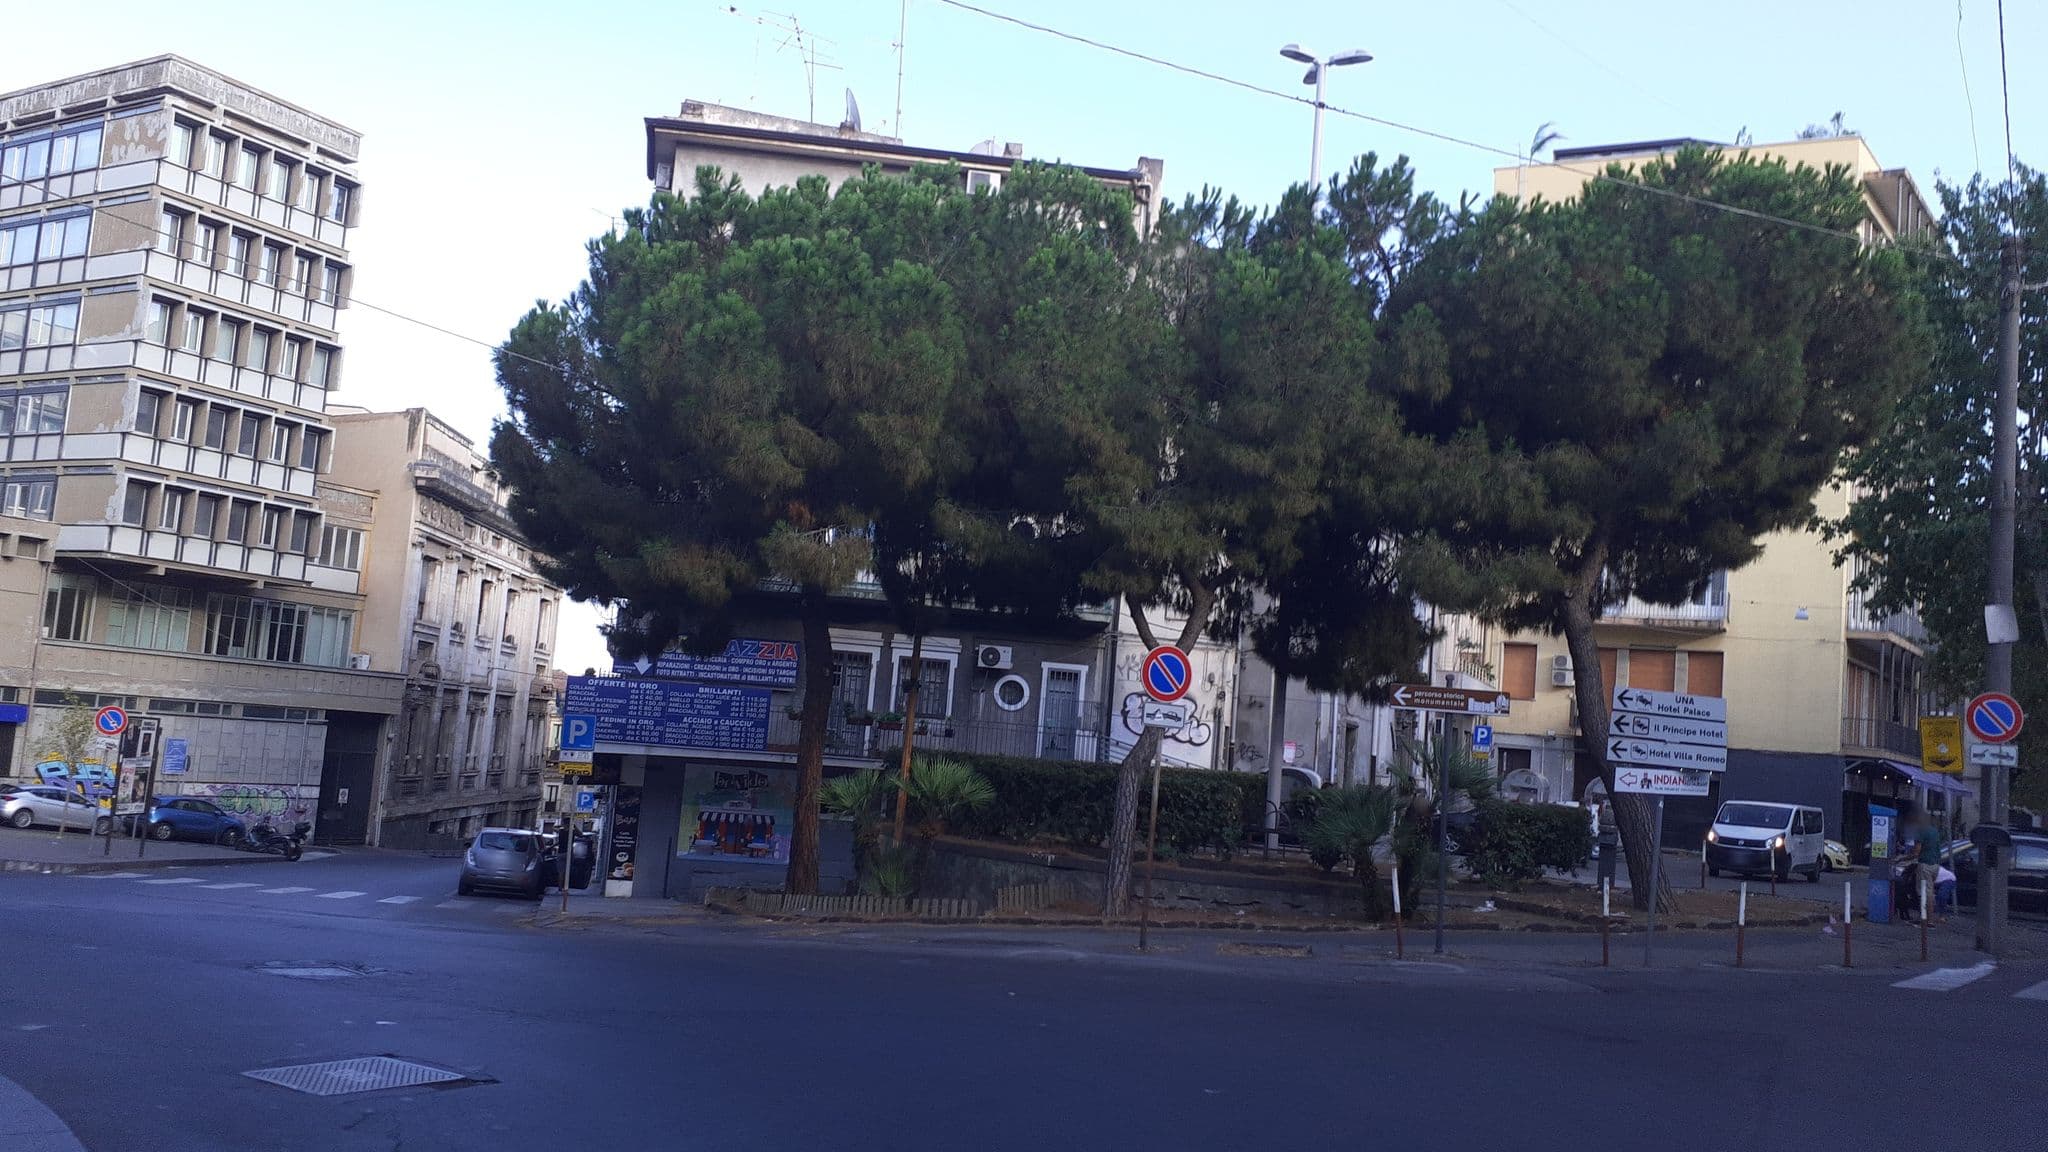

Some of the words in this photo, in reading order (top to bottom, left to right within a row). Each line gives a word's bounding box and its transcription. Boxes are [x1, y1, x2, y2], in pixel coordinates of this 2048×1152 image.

[694, 664, 721, 672] CREAZIONI
[588, 679, 626, 688] OFFERTE
[699, 687, 741, 695] BRILLANTI
[1414, 698, 1464, 707] monumentale
[1675, 696, 1694, 705] UNA
[1658, 704, 1680, 713] Hotel
[1684, 707, 1710, 717] Palace
[569, 720, 587, 744] P
[1477, 728, 1488, 743] P
[1663, 725, 1696, 736] Principe
[1700, 729, 1723, 738] Hotel
[1650, 749, 1670, 758] Hotel
[1674, 752, 1693, 760] Villa
[1696, 754, 1725, 763] Romeo
[581, 794, 590, 806] P
